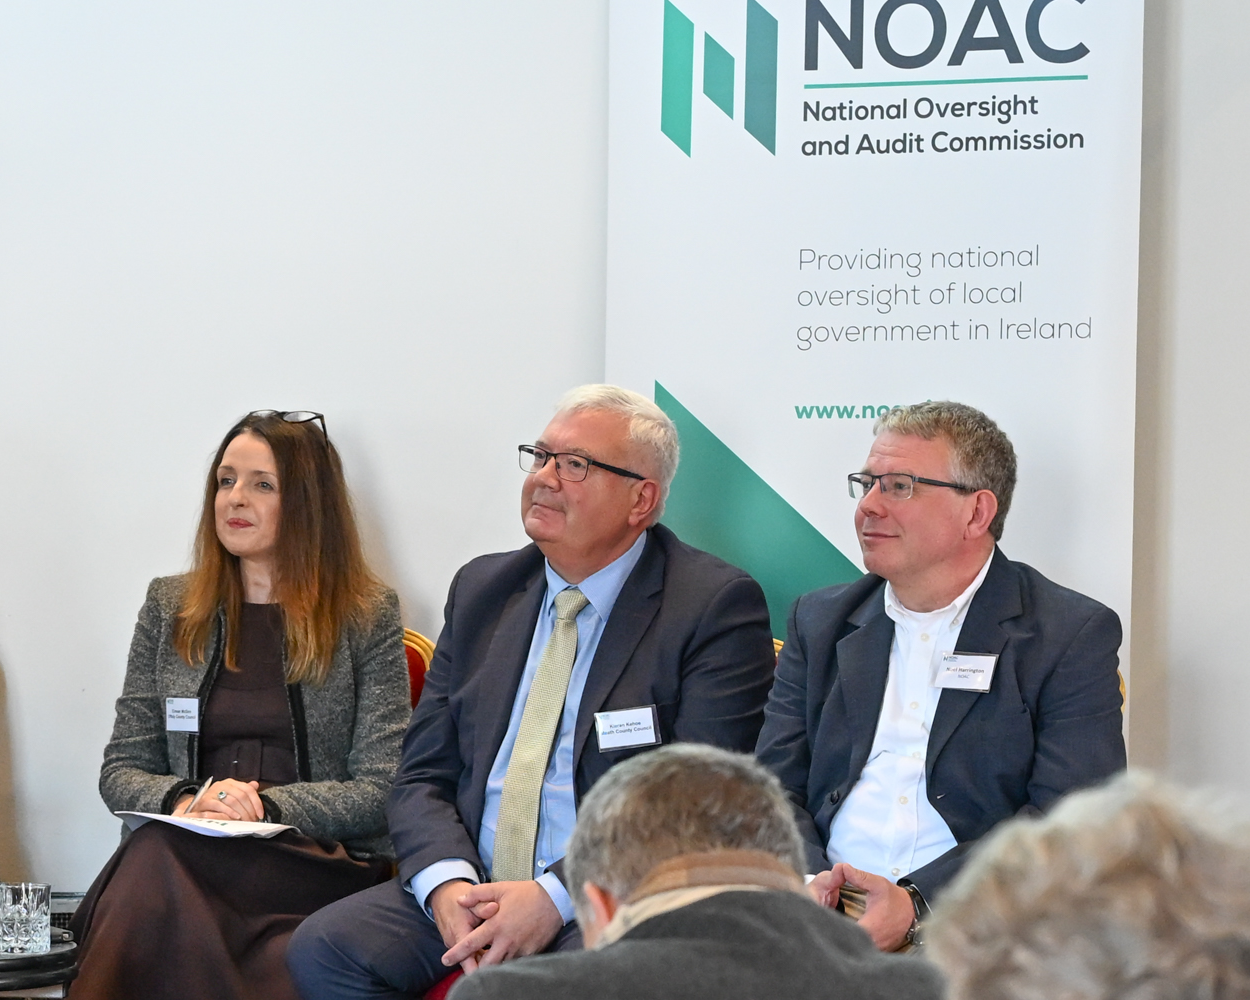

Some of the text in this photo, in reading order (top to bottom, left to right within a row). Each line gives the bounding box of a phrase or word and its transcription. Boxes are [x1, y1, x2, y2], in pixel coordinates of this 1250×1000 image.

[804, 0, 1090, 70] NOAC
[803, 95, 1039, 124] National Oversight
[801, 128, 1085, 156] and Audit Commission
[799, 245, 1039, 278] Providing national
[797, 281, 1022, 314] oversight of local
[796, 316, 1092, 351] government in Ireland
[794, 400, 932, 419] www.no
